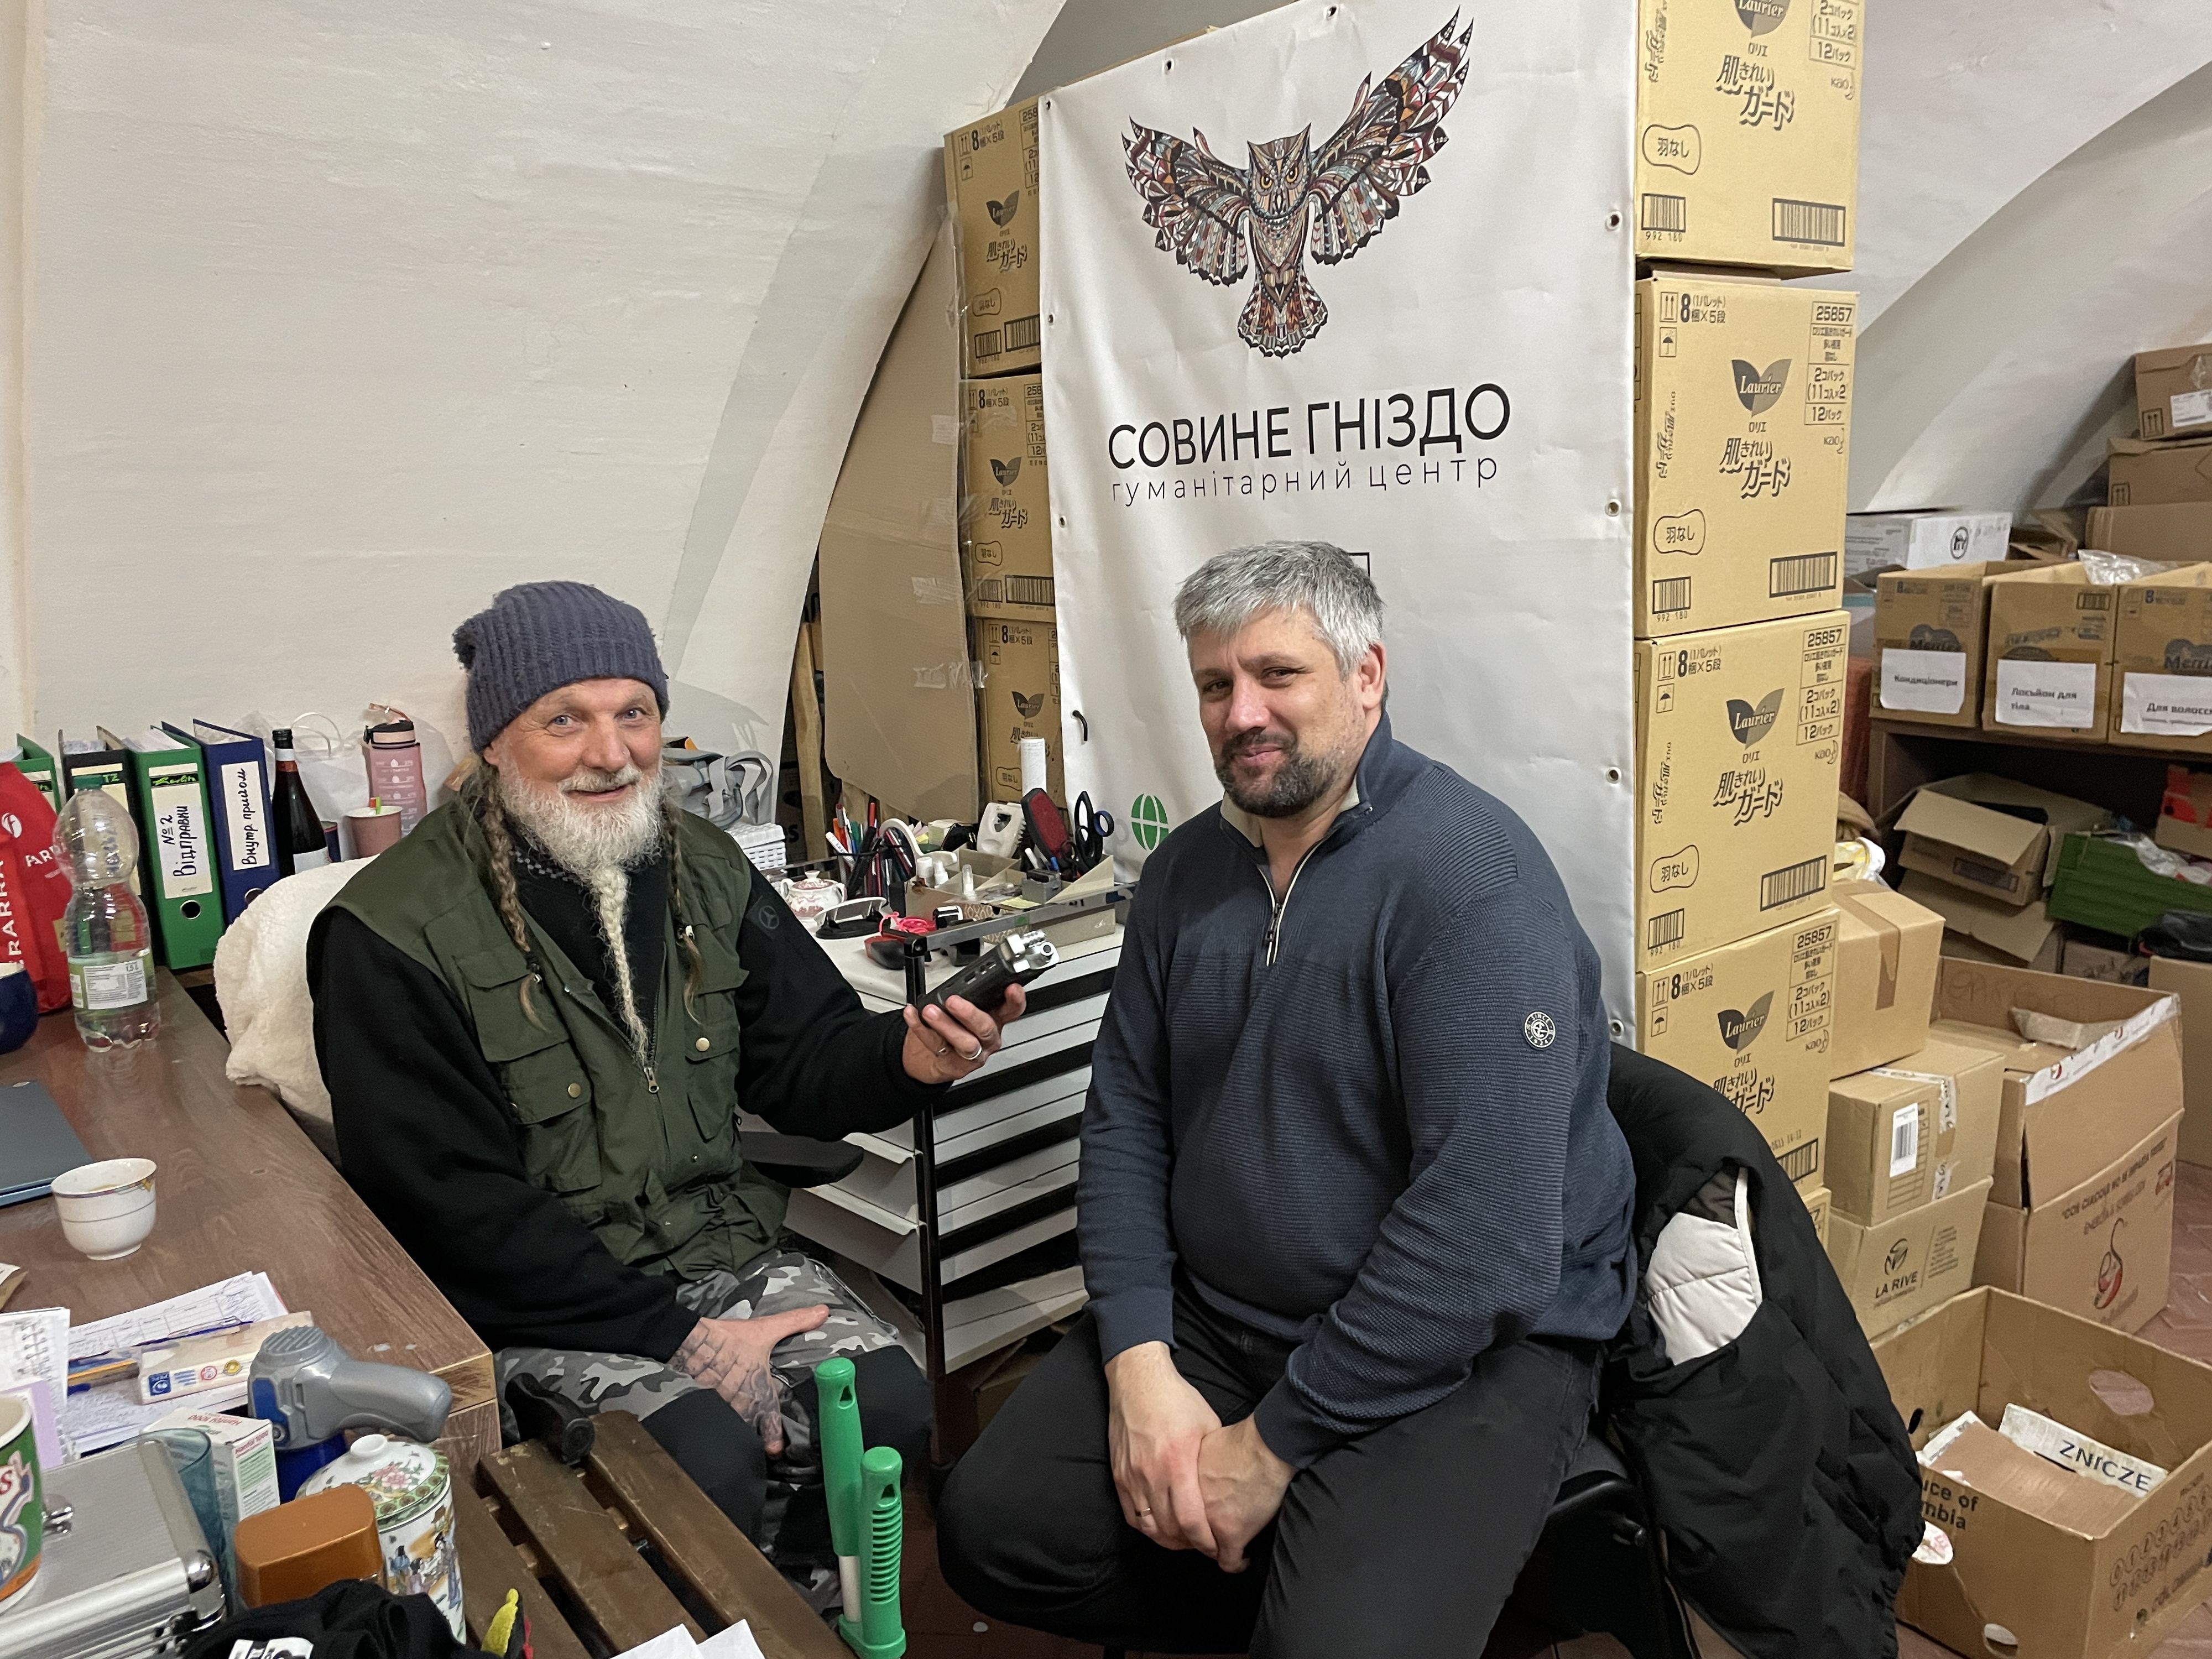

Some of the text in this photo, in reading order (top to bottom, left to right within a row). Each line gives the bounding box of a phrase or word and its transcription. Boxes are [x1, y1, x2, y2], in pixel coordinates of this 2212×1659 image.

[1022, 107, 1038, 122] 258
[1657, 138, 1689, 158] 羽なし
[1680, 294, 1691, 322] 8
[1816, 305, 1852, 322] 25857
[1027, 385, 1042, 395] 258
[1740, 374, 1782, 395] Laurier
[1108, 383, 1511, 469] СОВИНЕ ГНІЗДО
[1749, 422, 1767, 432] ロリエ
[1112, 457, 1498, 507] гуманітарний центр
[1741, 457, 1791, 499] ガード
[1666, 525, 1694, 543] 羽なし
[1808, 629, 1842, 648] 25857
[1678, 650, 1688, 677] 8
[2146, 702, 2168, 712] Для
[1734, 706, 1775, 731] Laurier
[1742, 750, 1760, 763] ロリエ
[103, 773, 119, 783] TZ
[1713, 767, 1766, 807] 肌きれい
[1734, 778, 1783, 826] ガード
[242, 824, 259, 864] Внутр
[1661, 862, 1689, 882] 羽なし
[1797, 926, 1832, 949] 25857
[1650, 946, 1663, 956] 992
[1671, 973, 1681, 1000] 8
[1797, 982, 1825, 1000] 2コパック
[1725, 1010, 1765, 1039] Laurier
[1794, 1014, 1823, 1032] 12パック
[1734, 1052, 1751, 1068] ロリエ
[1876, 1271, 1918, 1298] LA RIVE
[2059, 1439, 2152, 1493] ZNICZE
[1959, 1496, 1979, 1511] of
